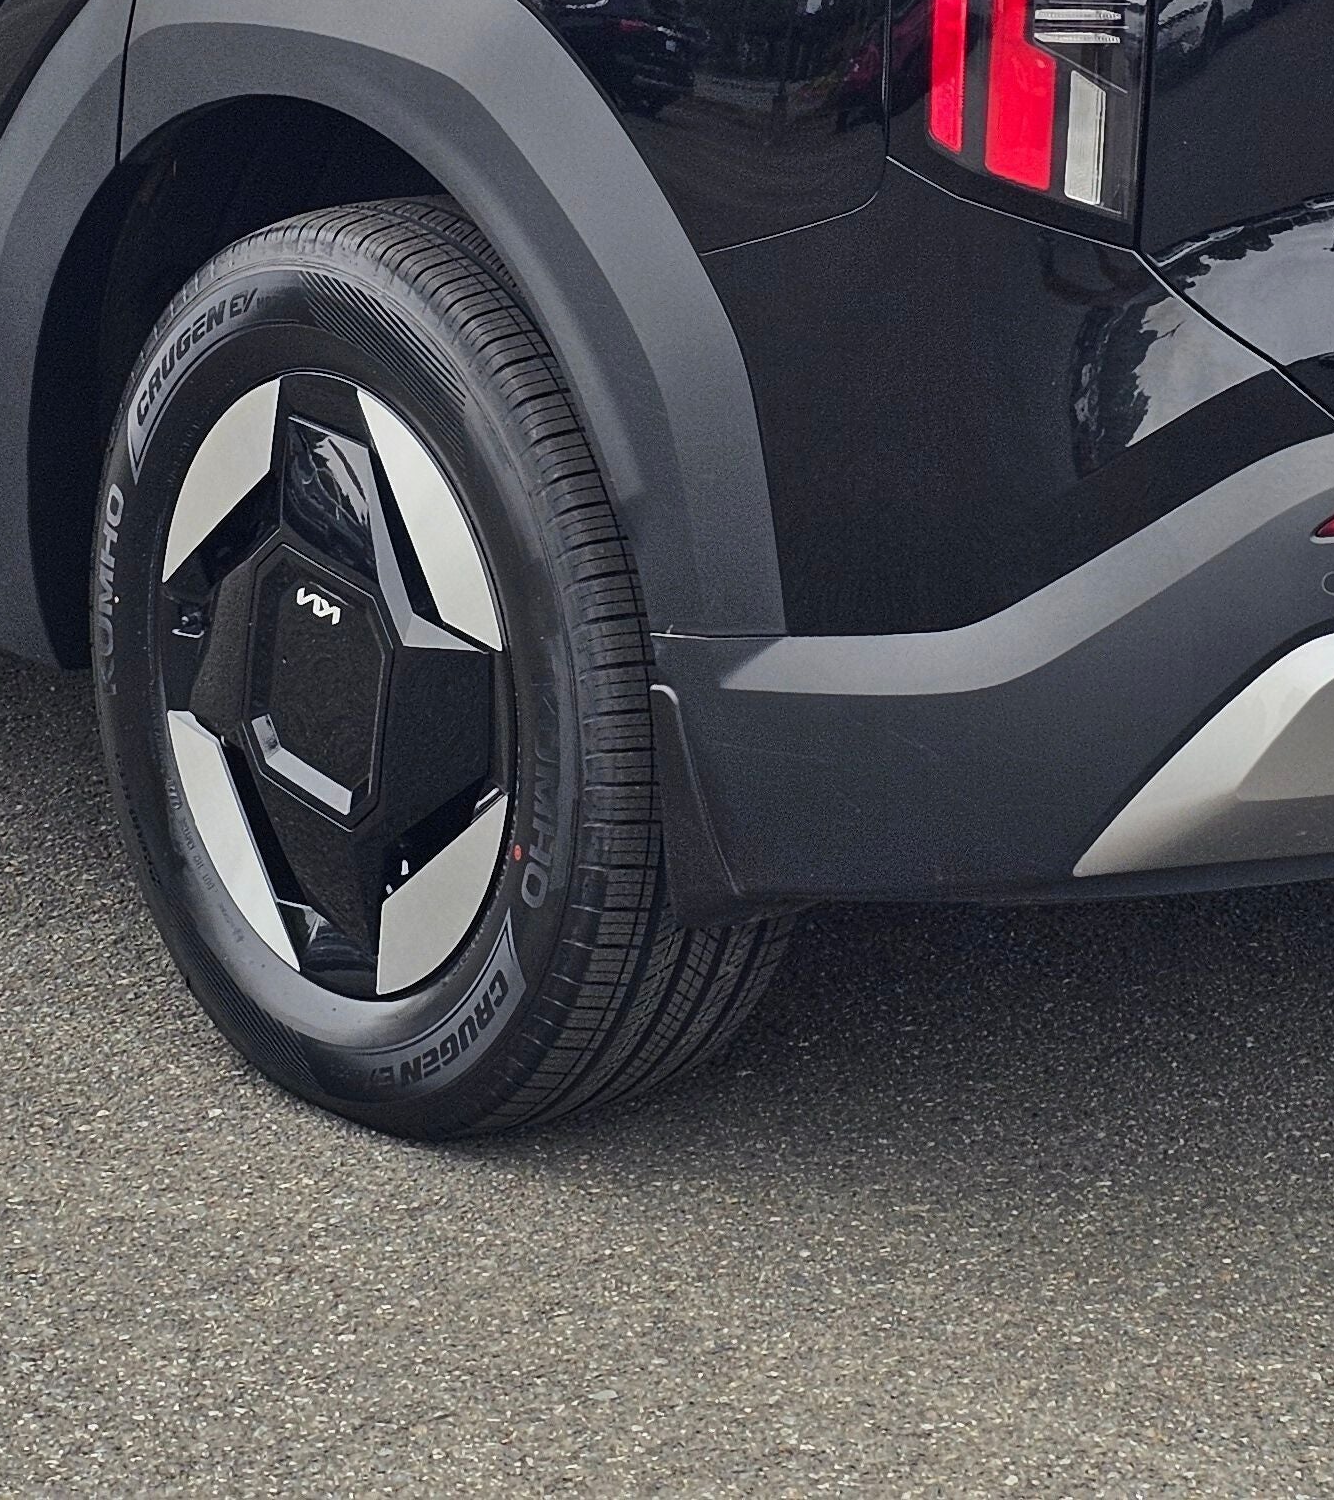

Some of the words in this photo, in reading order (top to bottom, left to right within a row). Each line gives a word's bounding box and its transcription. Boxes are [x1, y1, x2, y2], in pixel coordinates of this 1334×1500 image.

[137, 299, 226, 427] CRUGEN
[95, 483, 125, 696] KUMHO
[400, 969, 509, 1088] CRUGEN
